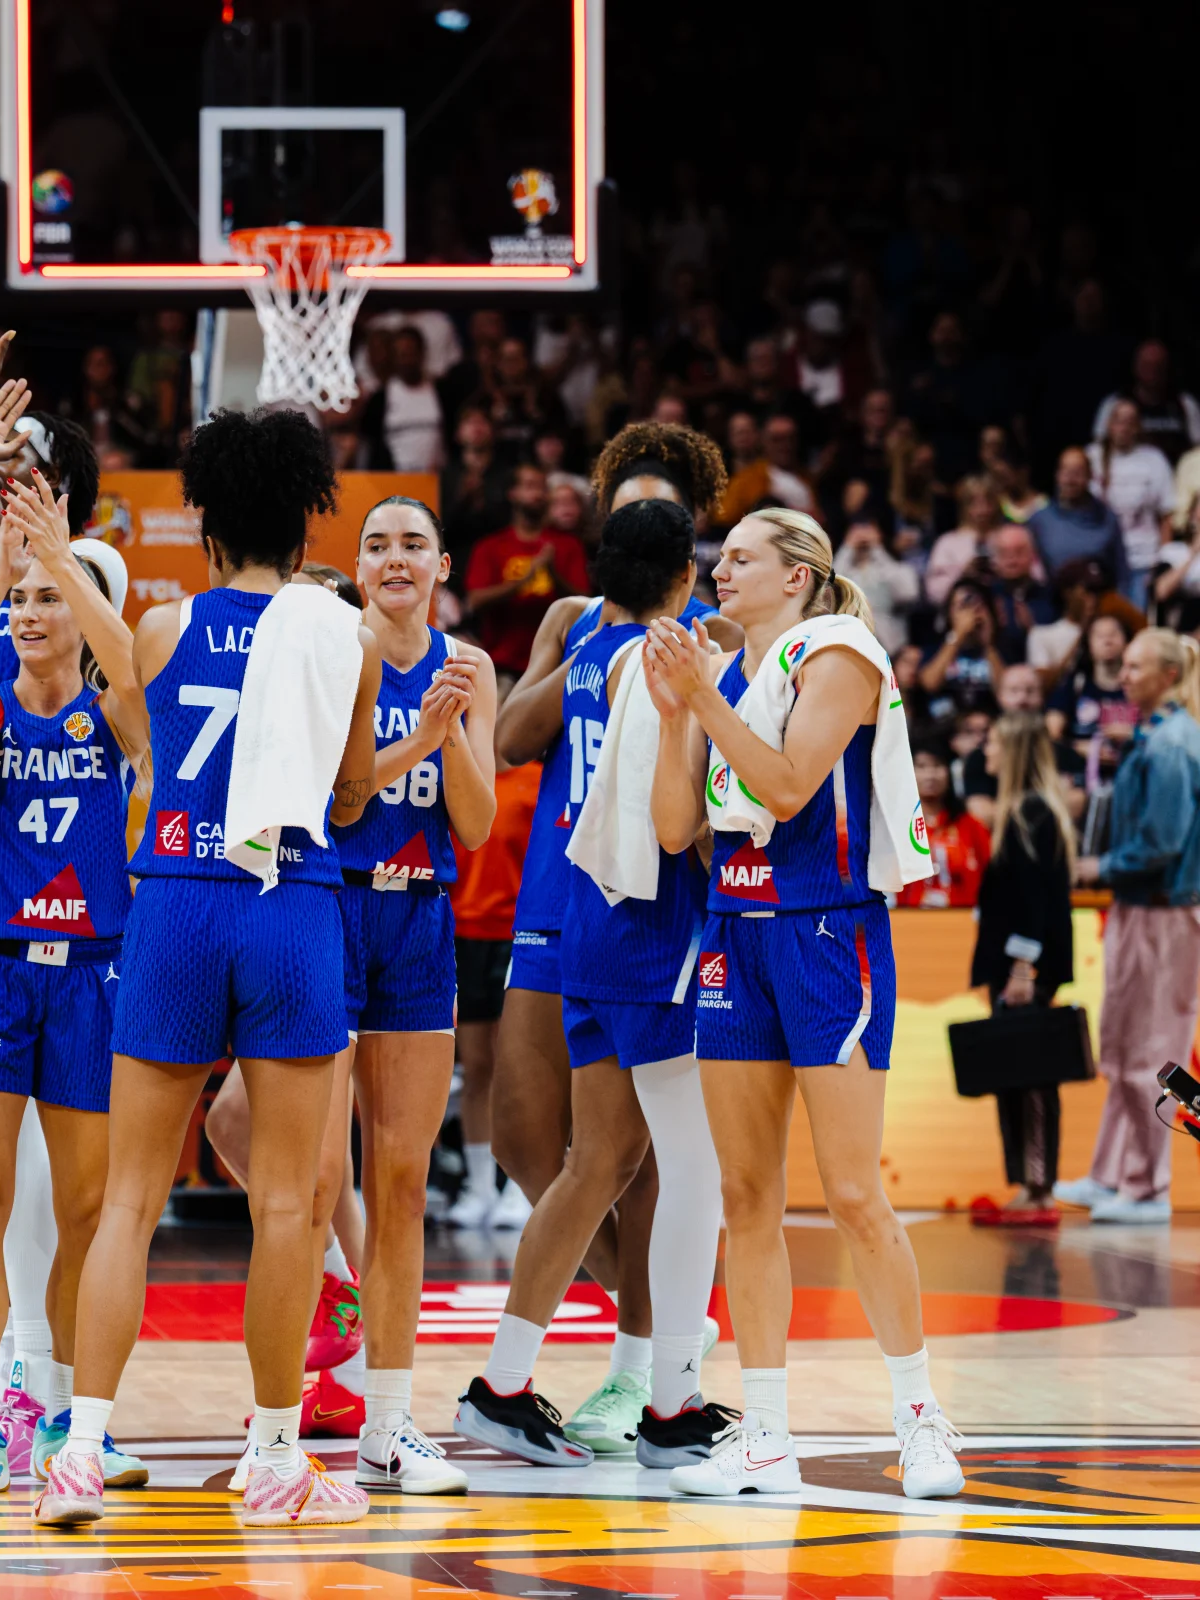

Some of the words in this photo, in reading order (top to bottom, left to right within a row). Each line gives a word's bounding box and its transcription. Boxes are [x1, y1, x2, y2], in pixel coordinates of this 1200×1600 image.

[131, 579, 188, 601] TCL
[206, 624, 255, 654] LAC
[566, 663, 604, 702] WILLIAMS
[176, 684, 241, 781] 7
[18, 797, 80, 844] 47
[720, 865, 773, 887] MAIF
[23, 898, 87, 921] MAIF
